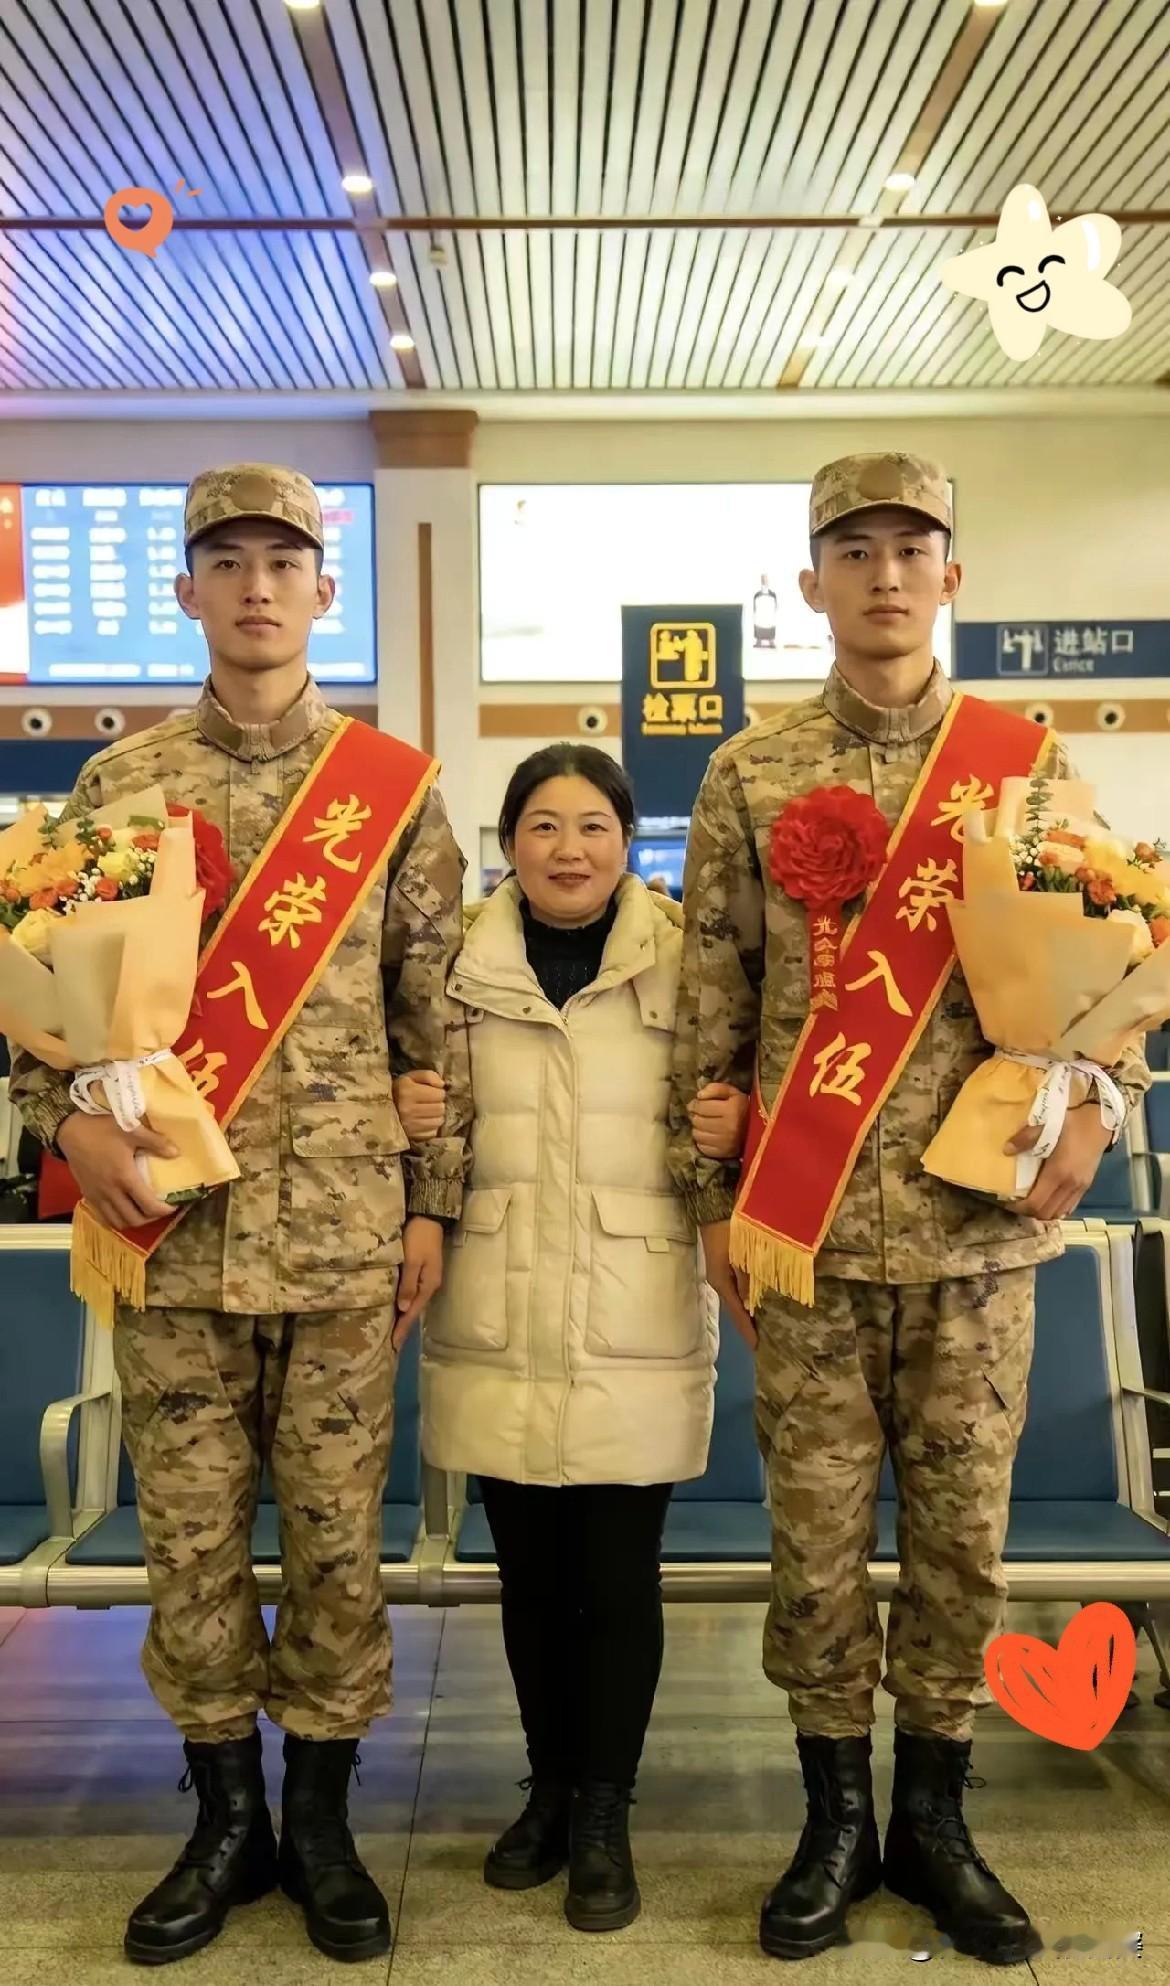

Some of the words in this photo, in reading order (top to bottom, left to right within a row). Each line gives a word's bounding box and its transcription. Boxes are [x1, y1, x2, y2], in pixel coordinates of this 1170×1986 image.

[1053, 626, 1134, 657] 进站口
[808, 773, 995, 1107] 光荣入伍
